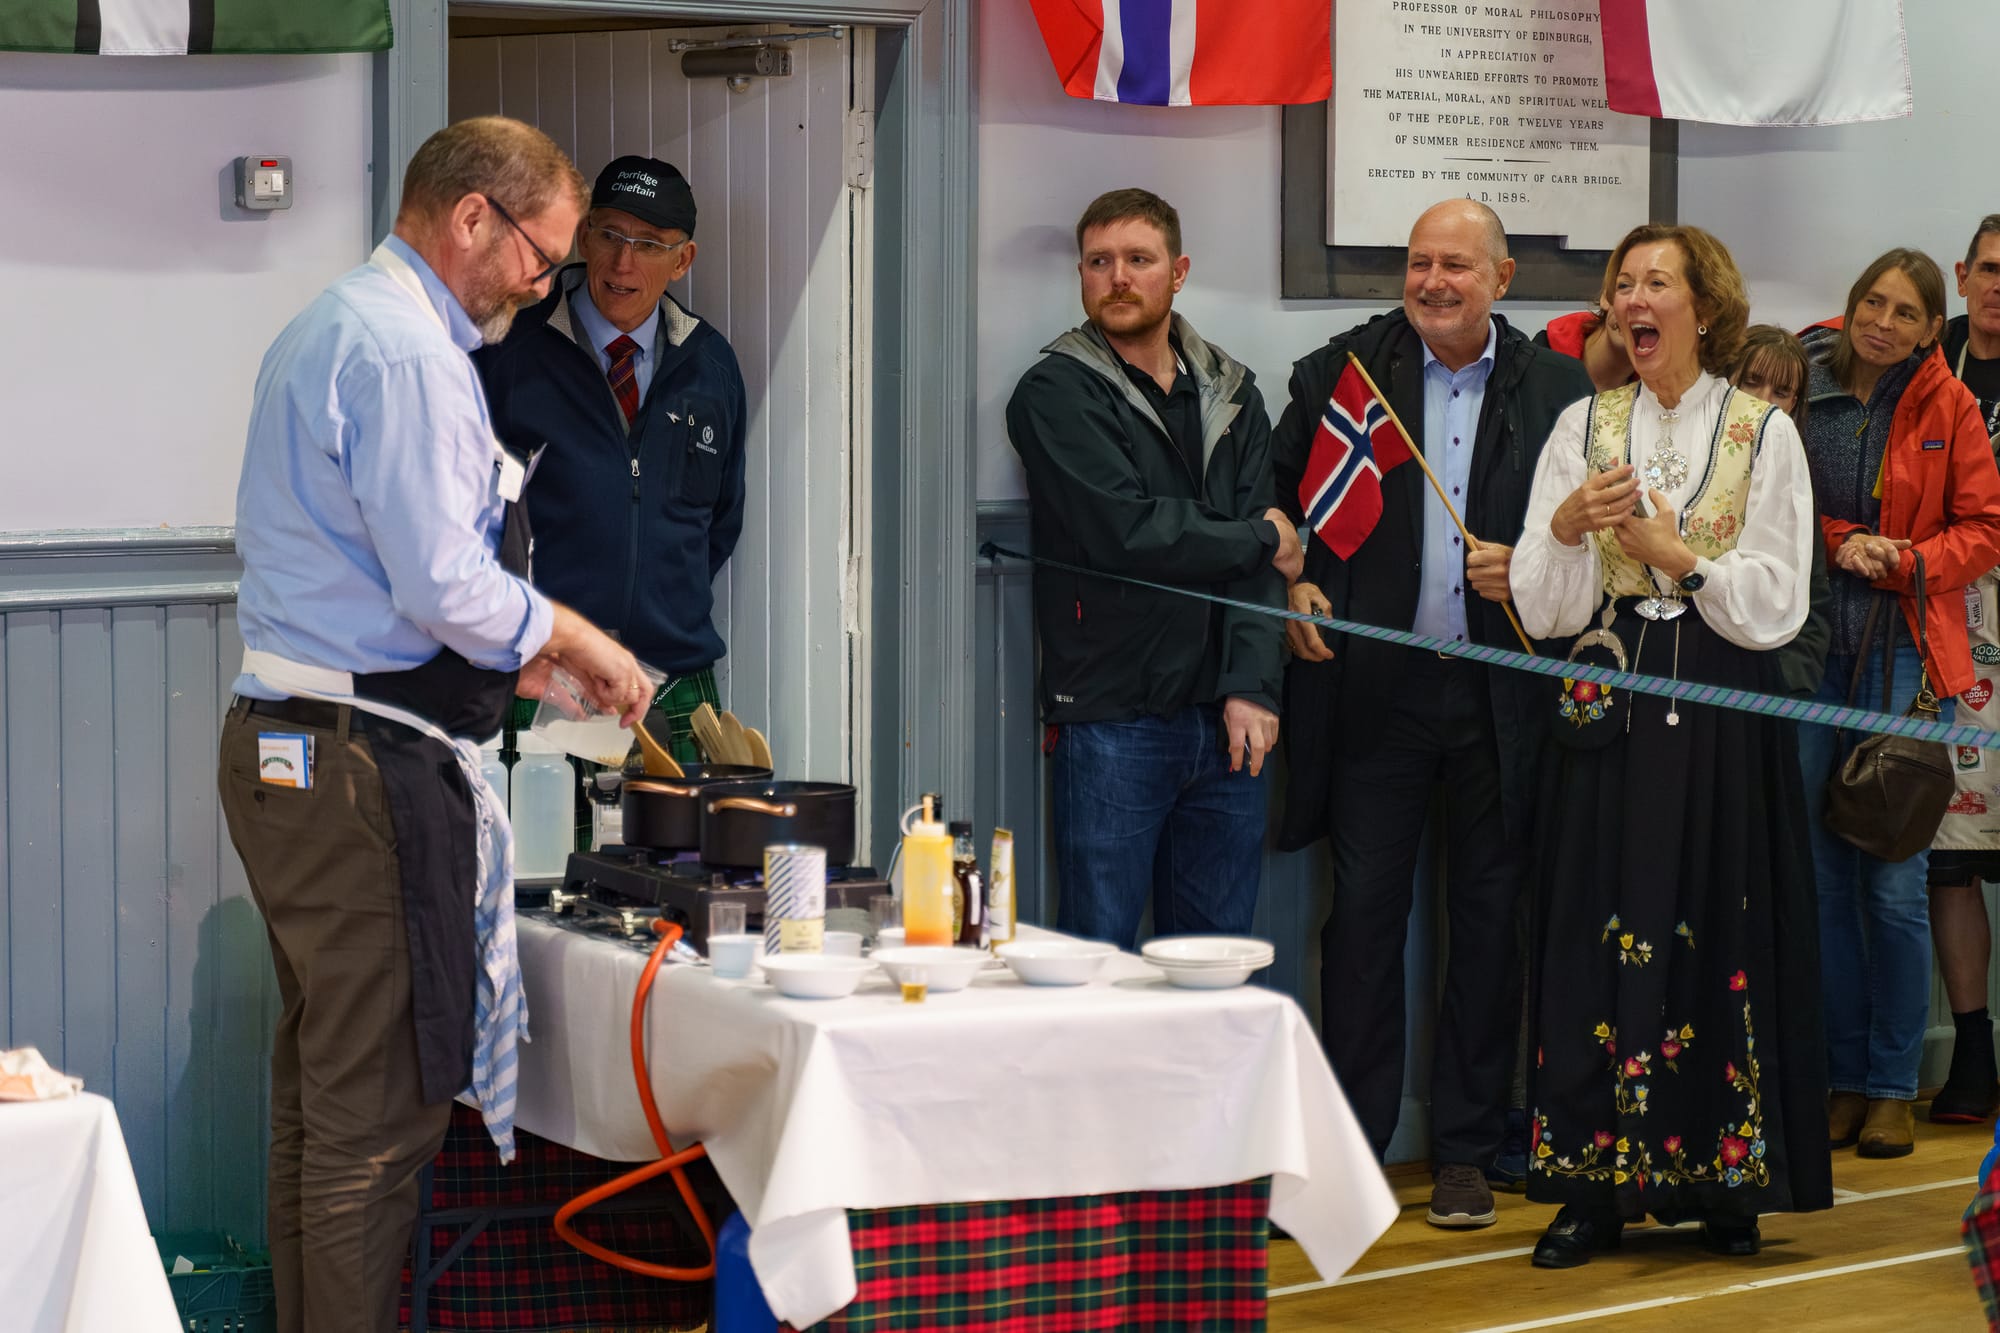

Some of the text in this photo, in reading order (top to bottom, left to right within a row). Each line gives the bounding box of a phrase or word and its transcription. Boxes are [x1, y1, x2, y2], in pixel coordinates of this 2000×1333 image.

[1393, 1, 1600, 22] PROFESSOR OF MORAL PHILOSOPHY
[1404, 23, 1592, 45] IN THE UNIVERSITY OF EDINBURGH,
[1441, 48, 1555, 64] IN APPRECIATION OF
[1395, 68, 1599, 87] HIS UNWEARIED EFFORTS TO PROMOTE
[1363, 88, 1382, 99] THE
[1386, 89, 1441, 103] MATERIAL,
[1445, 92, 1485, 105] MORAL,
[1490, 95, 1511, 105] AND
[1519, 96, 1576, 108] SPIRITUAL
[1388, 111, 1604, 130] OF THE PEOPLE, FOR TWELVE YEARS
[1395, 134, 1599, 151] OF SUMMER RESIDENCE AMONG THEM.
[617, 171, 658, 187] Porridge
[1368, 168, 1622, 185] ERECTED BY THE COMMUNITY OF CARR BRIDGE.
[611, 183, 656, 198] Chieftain
[1481, 191, 1492, 202] D.
[1498, 192, 1530, 203] 1898.
[1972, 602, 1981, 623] Milk
[1975, 645, 2000, 656] 100%
